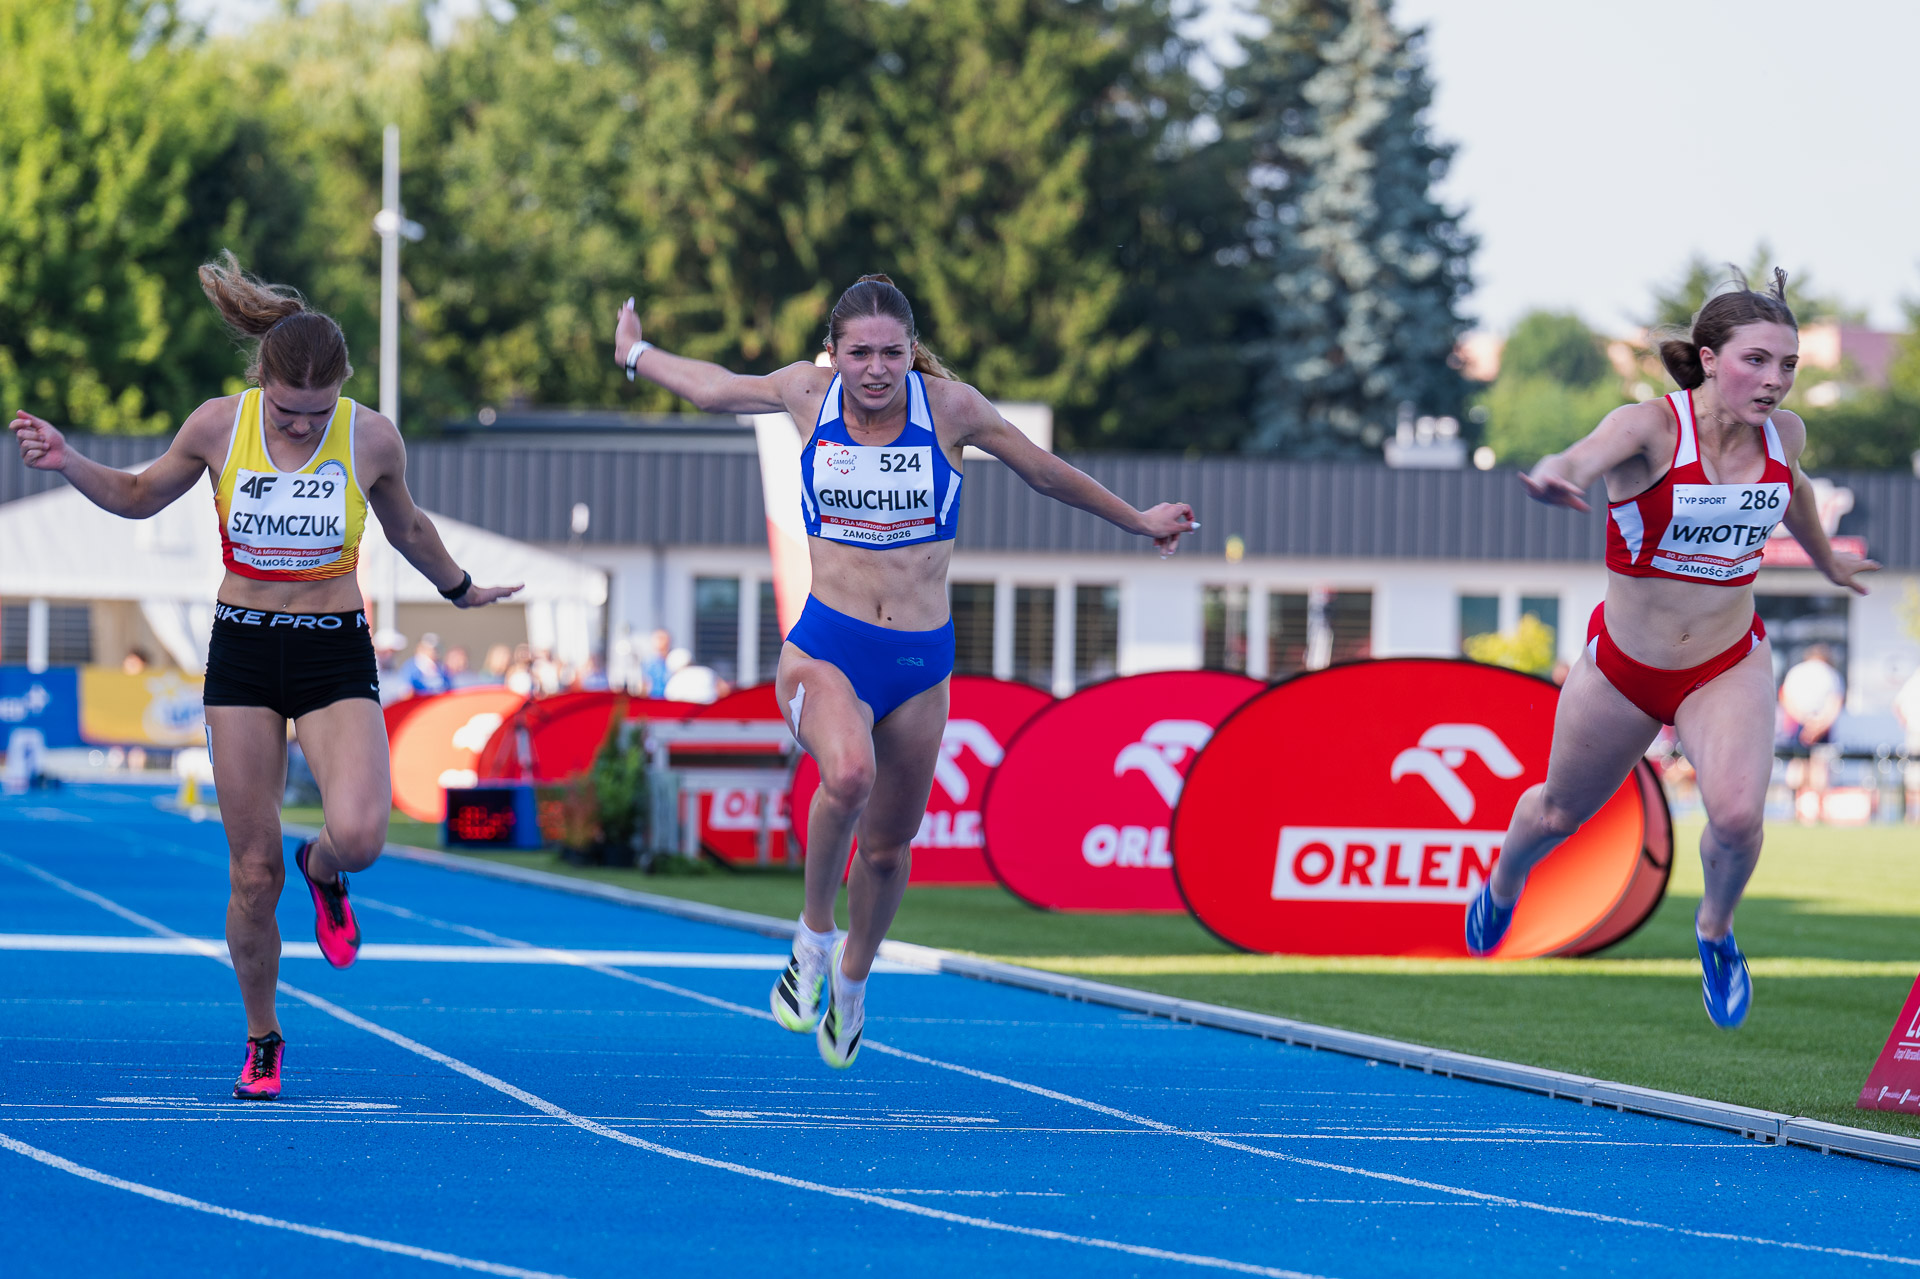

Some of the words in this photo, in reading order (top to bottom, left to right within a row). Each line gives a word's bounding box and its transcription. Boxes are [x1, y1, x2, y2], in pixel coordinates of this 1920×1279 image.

[879, 453, 921, 473] 524
[240, 476, 278, 499] 4F
[292, 480, 335, 499] 229
[819, 489, 929, 511] GRUCHLIK
[1678, 497, 1697, 505] TVP
[1698, 497, 1727, 505] SPORT
[1739, 489, 1780, 511] 286
[232, 511, 340, 537] SZYMCZUK
[892, 521, 911, 530] Polski
[843, 529, 884, 542] ZAMOŚĆ
[886, 530, 911, 541] 2026
[1672, 524, 1775, 547] WROTEK
[251, 557, 294, 567] ZAMOŚĆ
[295, 558, 320, 567] 2026
[1676, 564, 1723, 577] ZAMOŚĆ
[269, 613, 343, 630] PRO
[897, 656, 925, 667] esa
[1292, 842, 1502, 888] ORLEN
